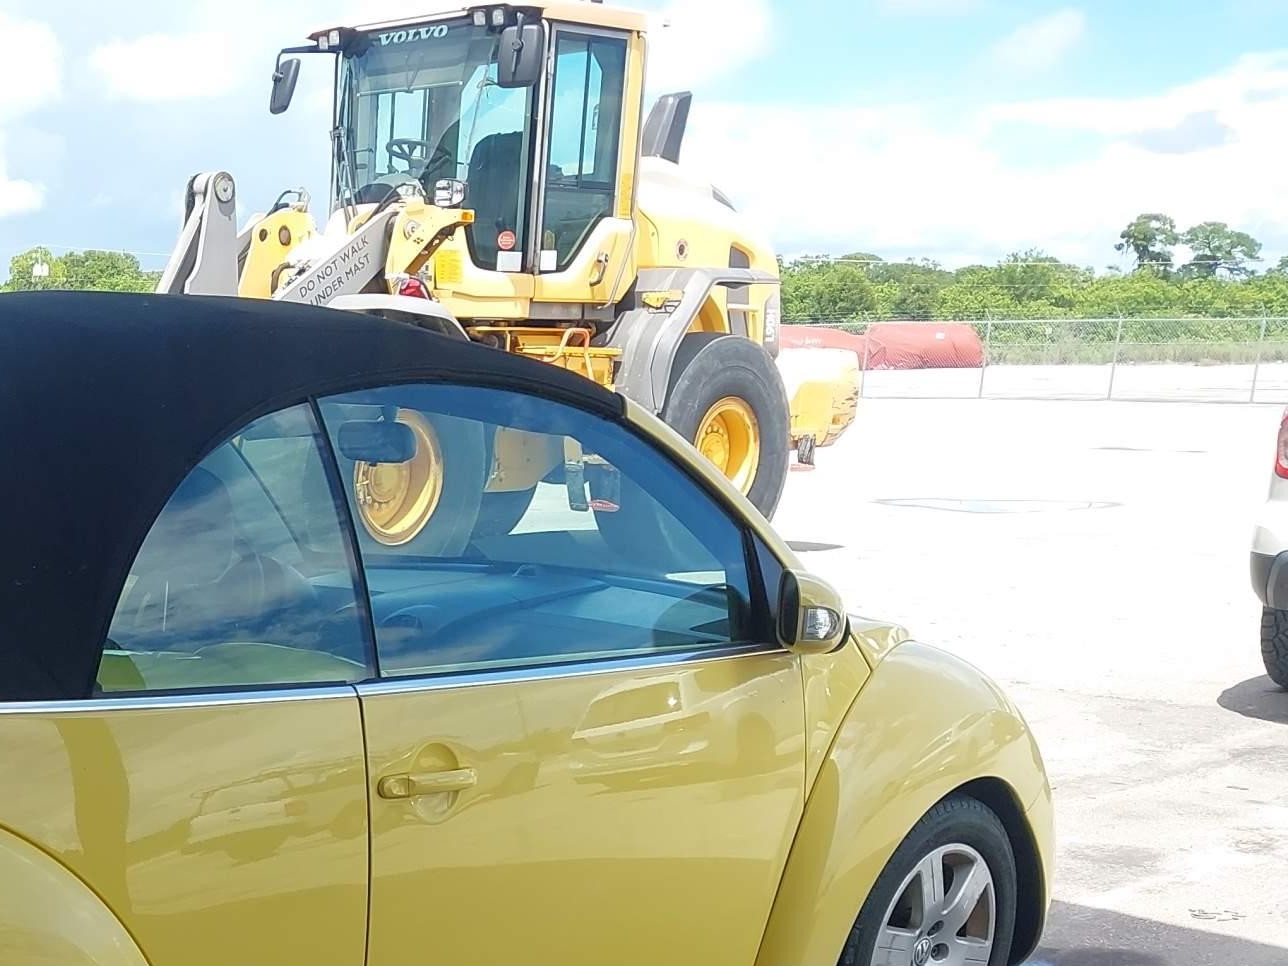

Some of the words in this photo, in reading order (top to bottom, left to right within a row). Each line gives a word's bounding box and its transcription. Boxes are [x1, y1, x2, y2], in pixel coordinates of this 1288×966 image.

[378, 24, 448, 46] VOLVO
[299, 279, 316, 298] DO
[316, 259, 338, 284] NOT
[339, 235, 369, 264] WALK
[310, 276, 344, 307] UNDER
[344, 253, 370, 281] MAST
